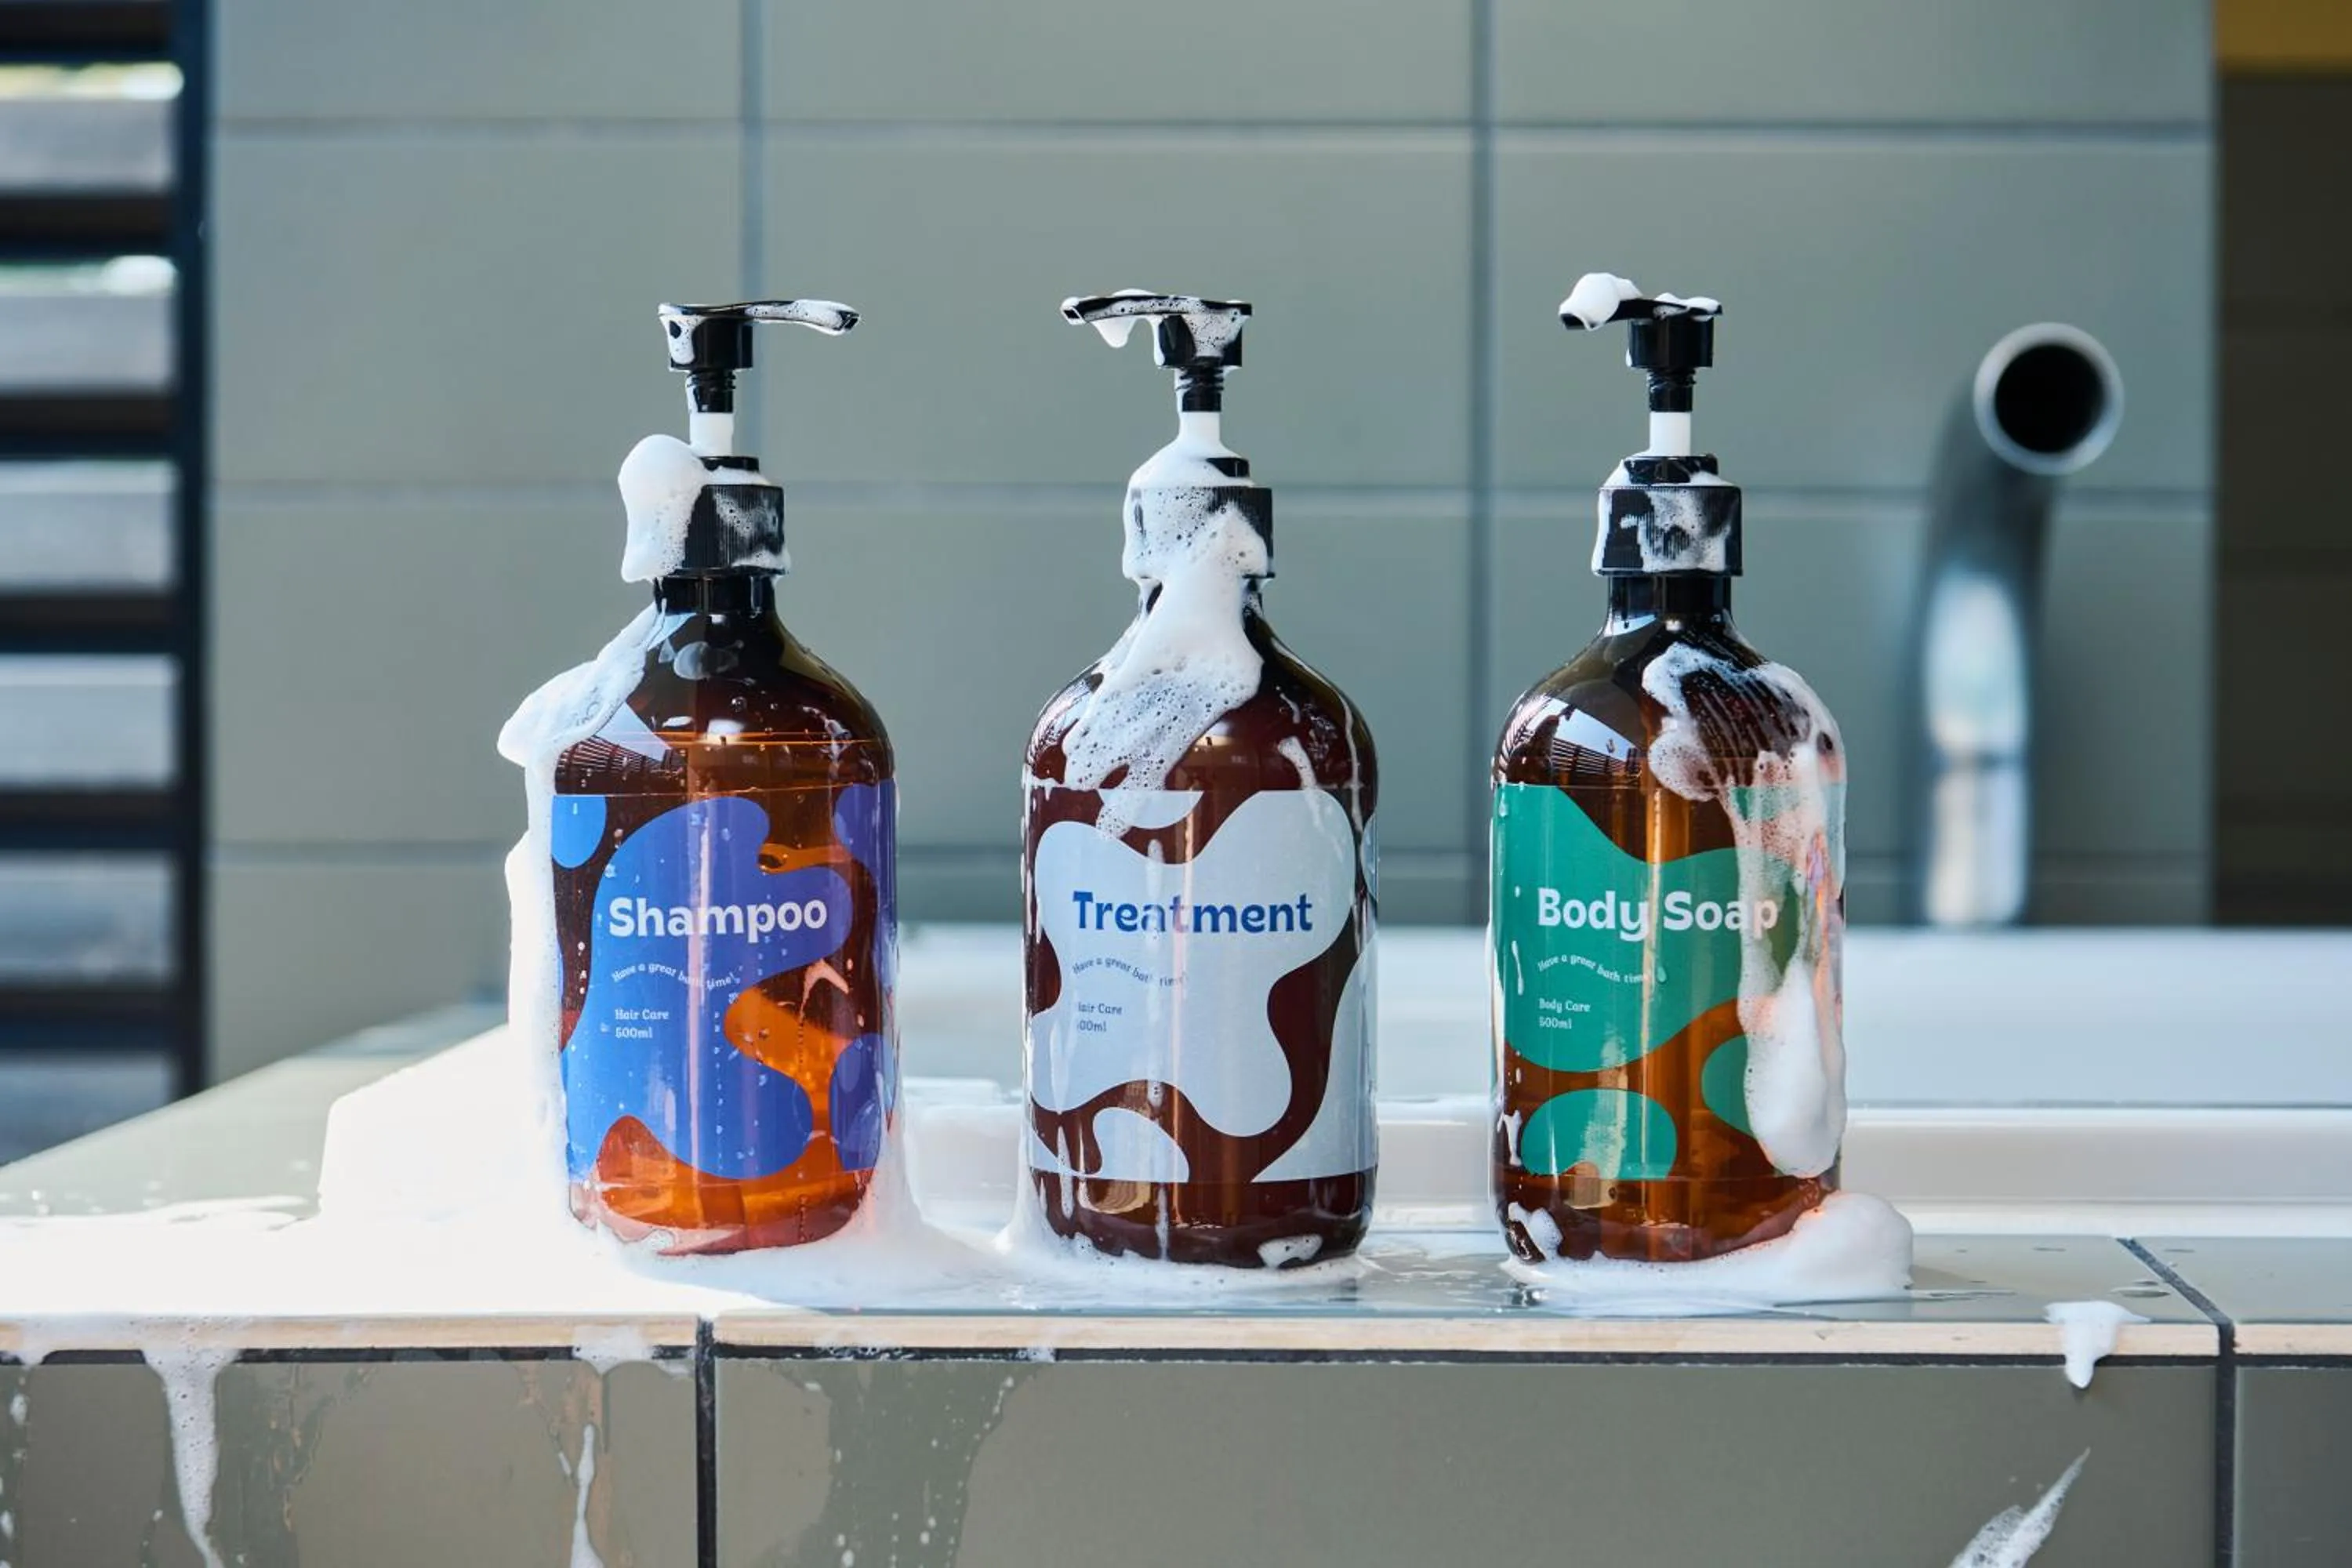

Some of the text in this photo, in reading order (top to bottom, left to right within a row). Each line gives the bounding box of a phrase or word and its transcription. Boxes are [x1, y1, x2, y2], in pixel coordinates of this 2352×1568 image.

[609, 898, 828, 942] Shampoo
[1073, 891, 1313, 933] Treatment
[1537, 887, 1778, 941] Body Soap
[612, 964, 636, 982] Have
[637, 963, 646, 971] a
[648, 963, 677, 977] great
[1132, 967, 1153, 983] bat
[1537, 956, 1559, 972] Have
[1570, 954, 1597, 970] great
[1596, 964, 1621, 982] bath
[615, 1007, 669, 1021] Hair Care
[1098, 1003, 1123, 1015] Care
[1539, 998, 1591, 1014] Body Care
[615, 1026, 652, 1039] 500ml
[1076, 1020, 1107, 1033] 00ml
[1539, 1017, 1572, 1033] 500ml
